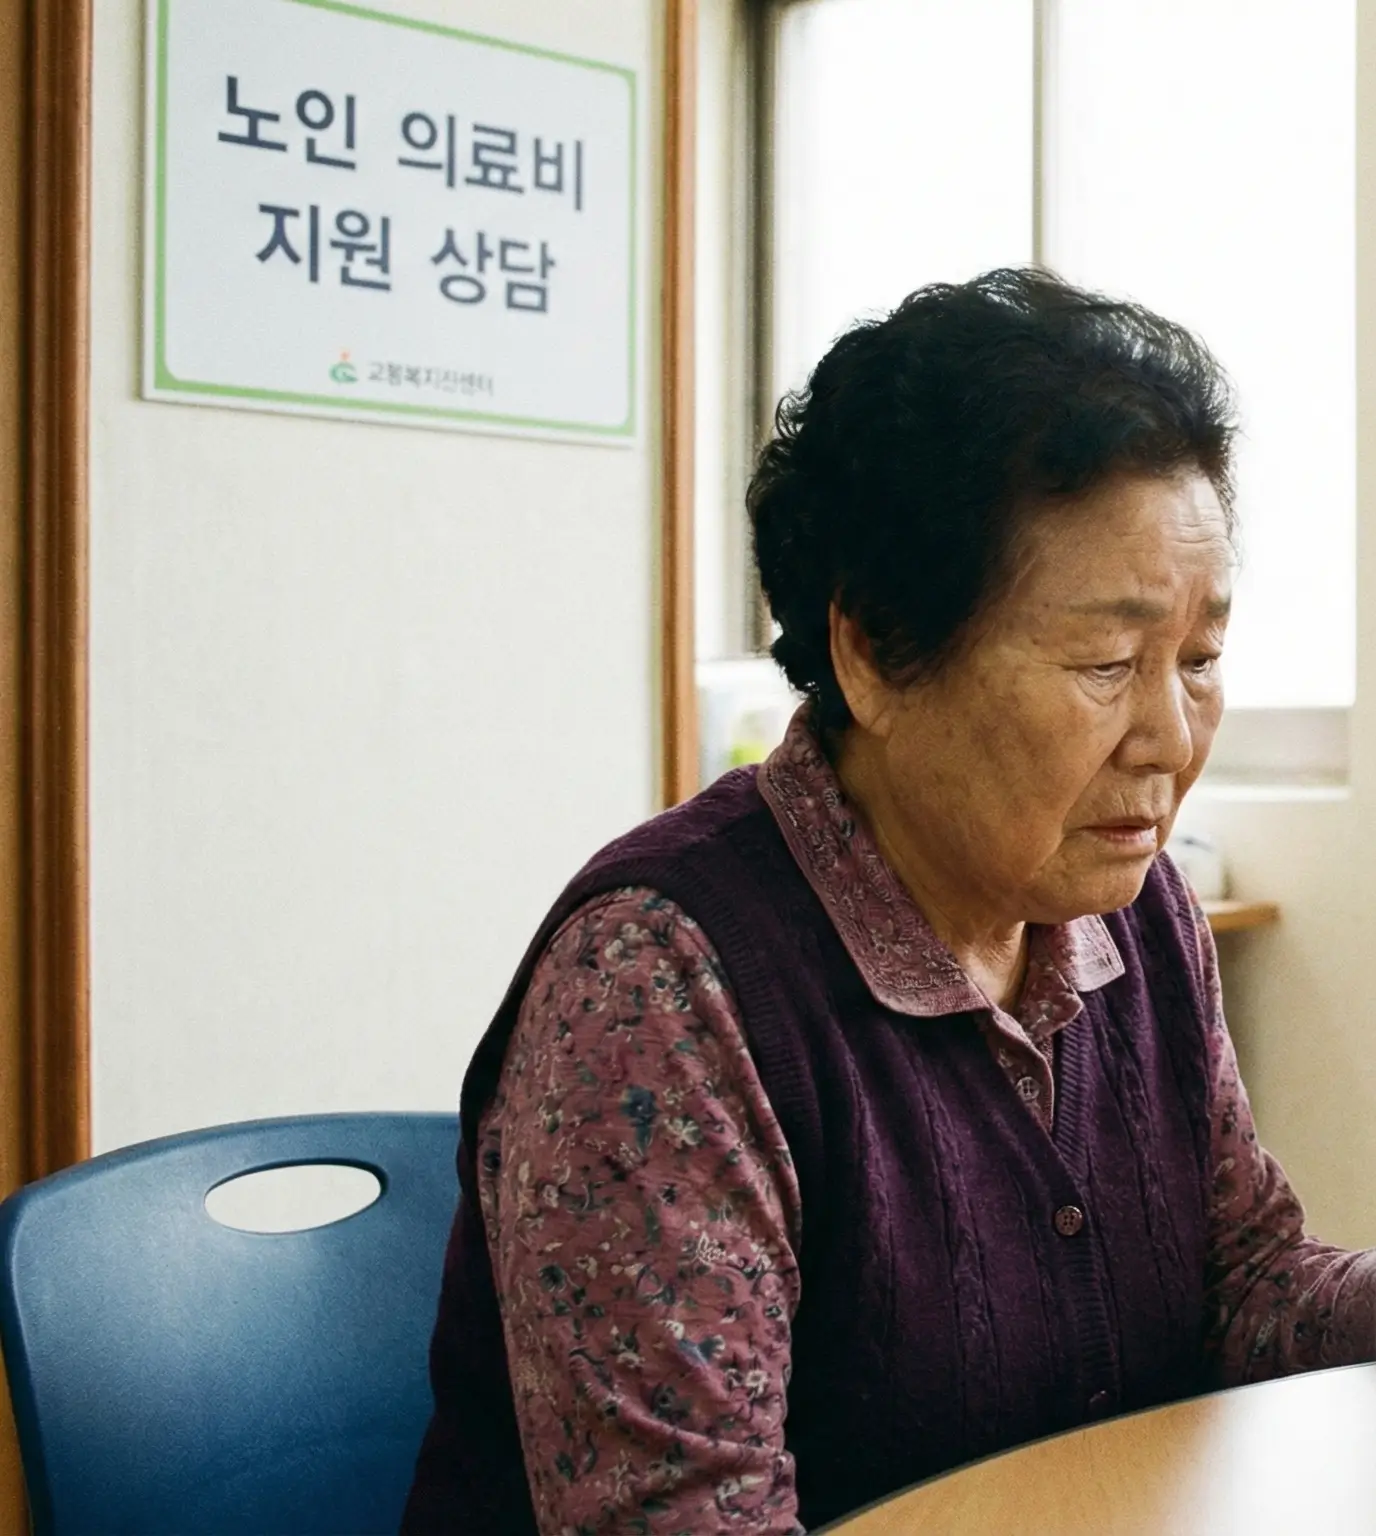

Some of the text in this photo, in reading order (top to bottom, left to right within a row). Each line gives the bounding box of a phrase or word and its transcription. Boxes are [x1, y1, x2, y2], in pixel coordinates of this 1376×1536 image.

[217, 75, 584, 213] 노인 의료비
[255, 203, 556, 314] 지원 상담
